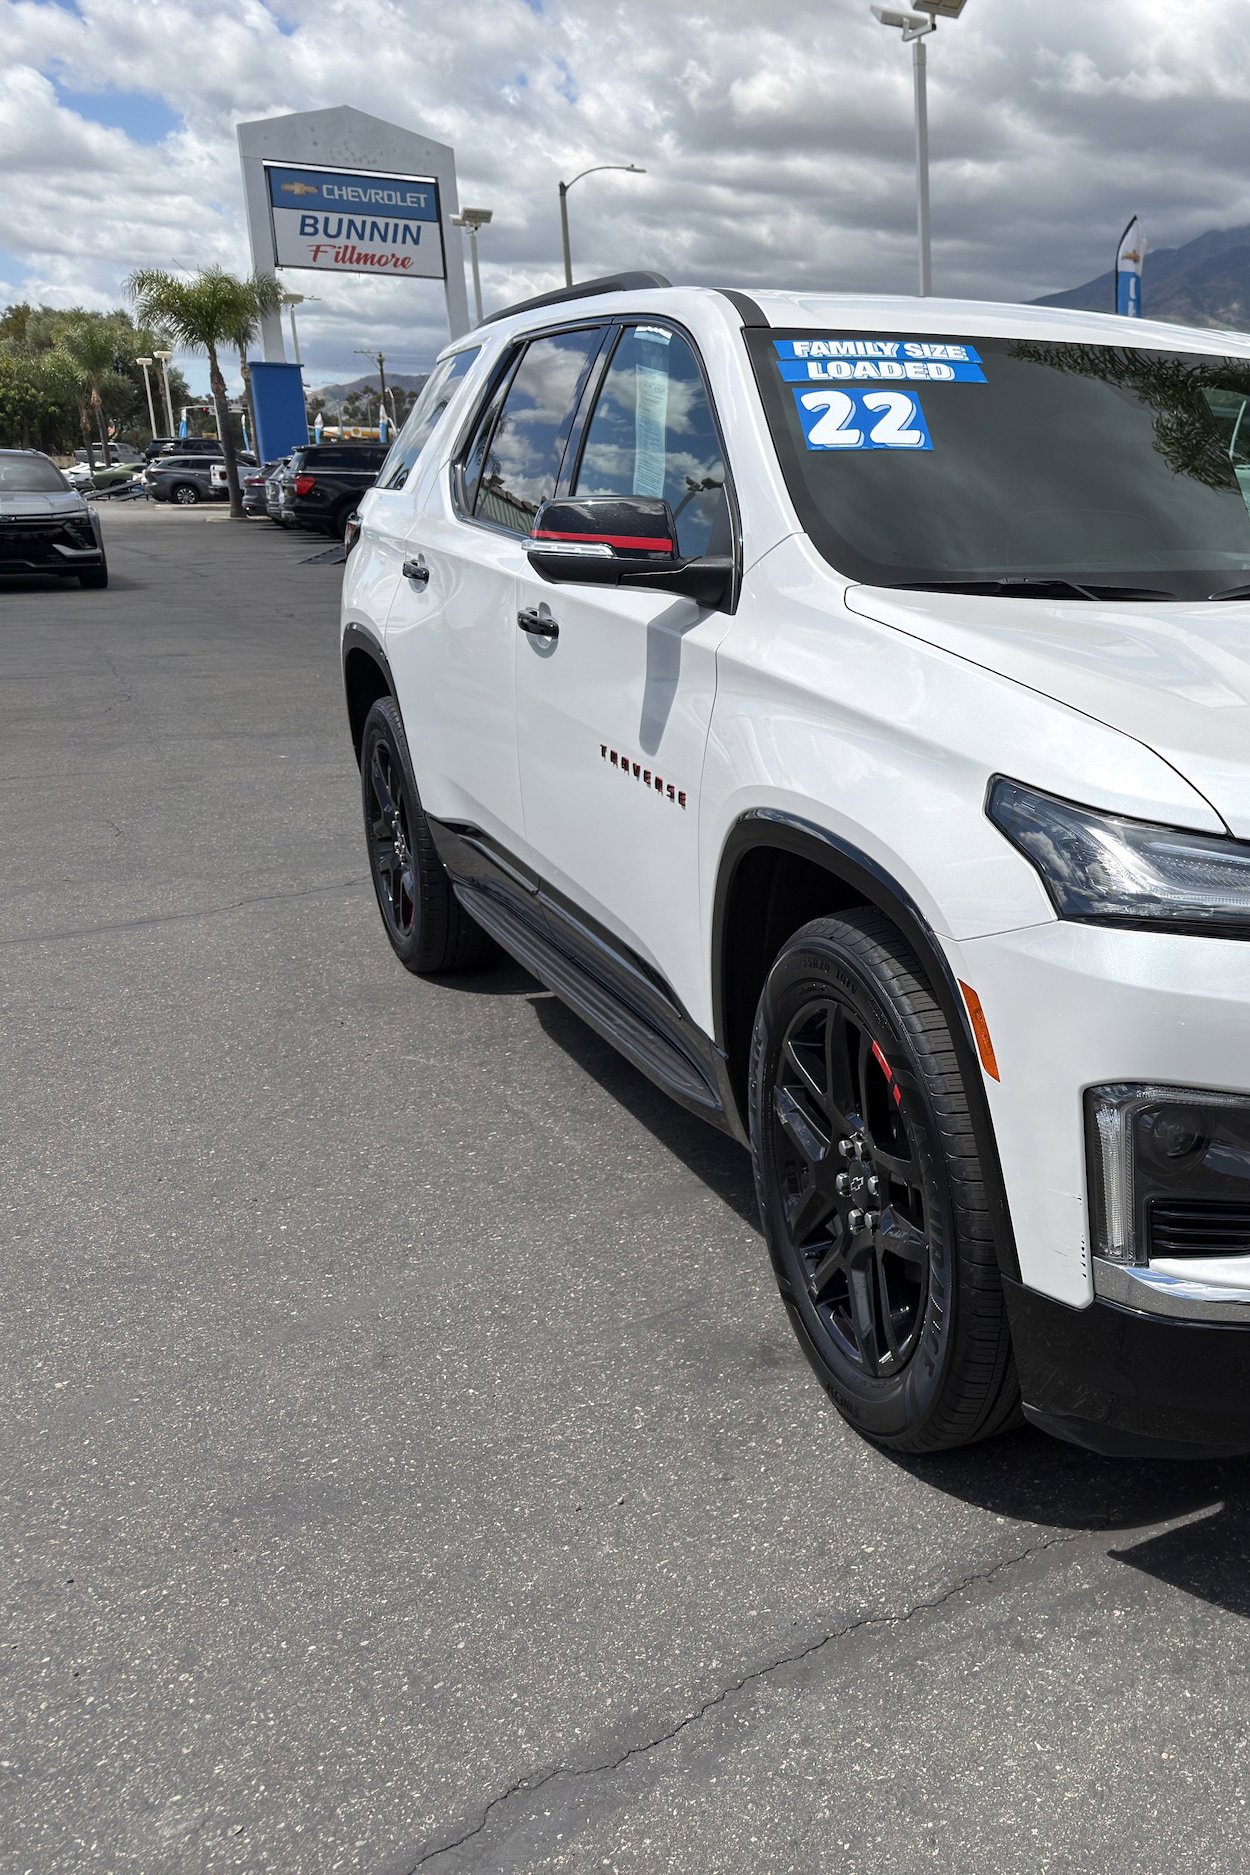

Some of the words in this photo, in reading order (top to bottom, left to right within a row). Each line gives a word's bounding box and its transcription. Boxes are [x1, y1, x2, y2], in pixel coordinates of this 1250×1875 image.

[322, 184, 427, 208] CHEVROLET
[299, 214, 421, 246] BUNNIN
[307, 244, 414, 270] Fillmore
[792, 341, 899, 358] FAMILY
[903, 343, 969, 360] SIZE
[807, 361, 955, 381] LOADED
[800, 390, 925, 447] 22
[600, 744, 686, 808] TRAVERSE
